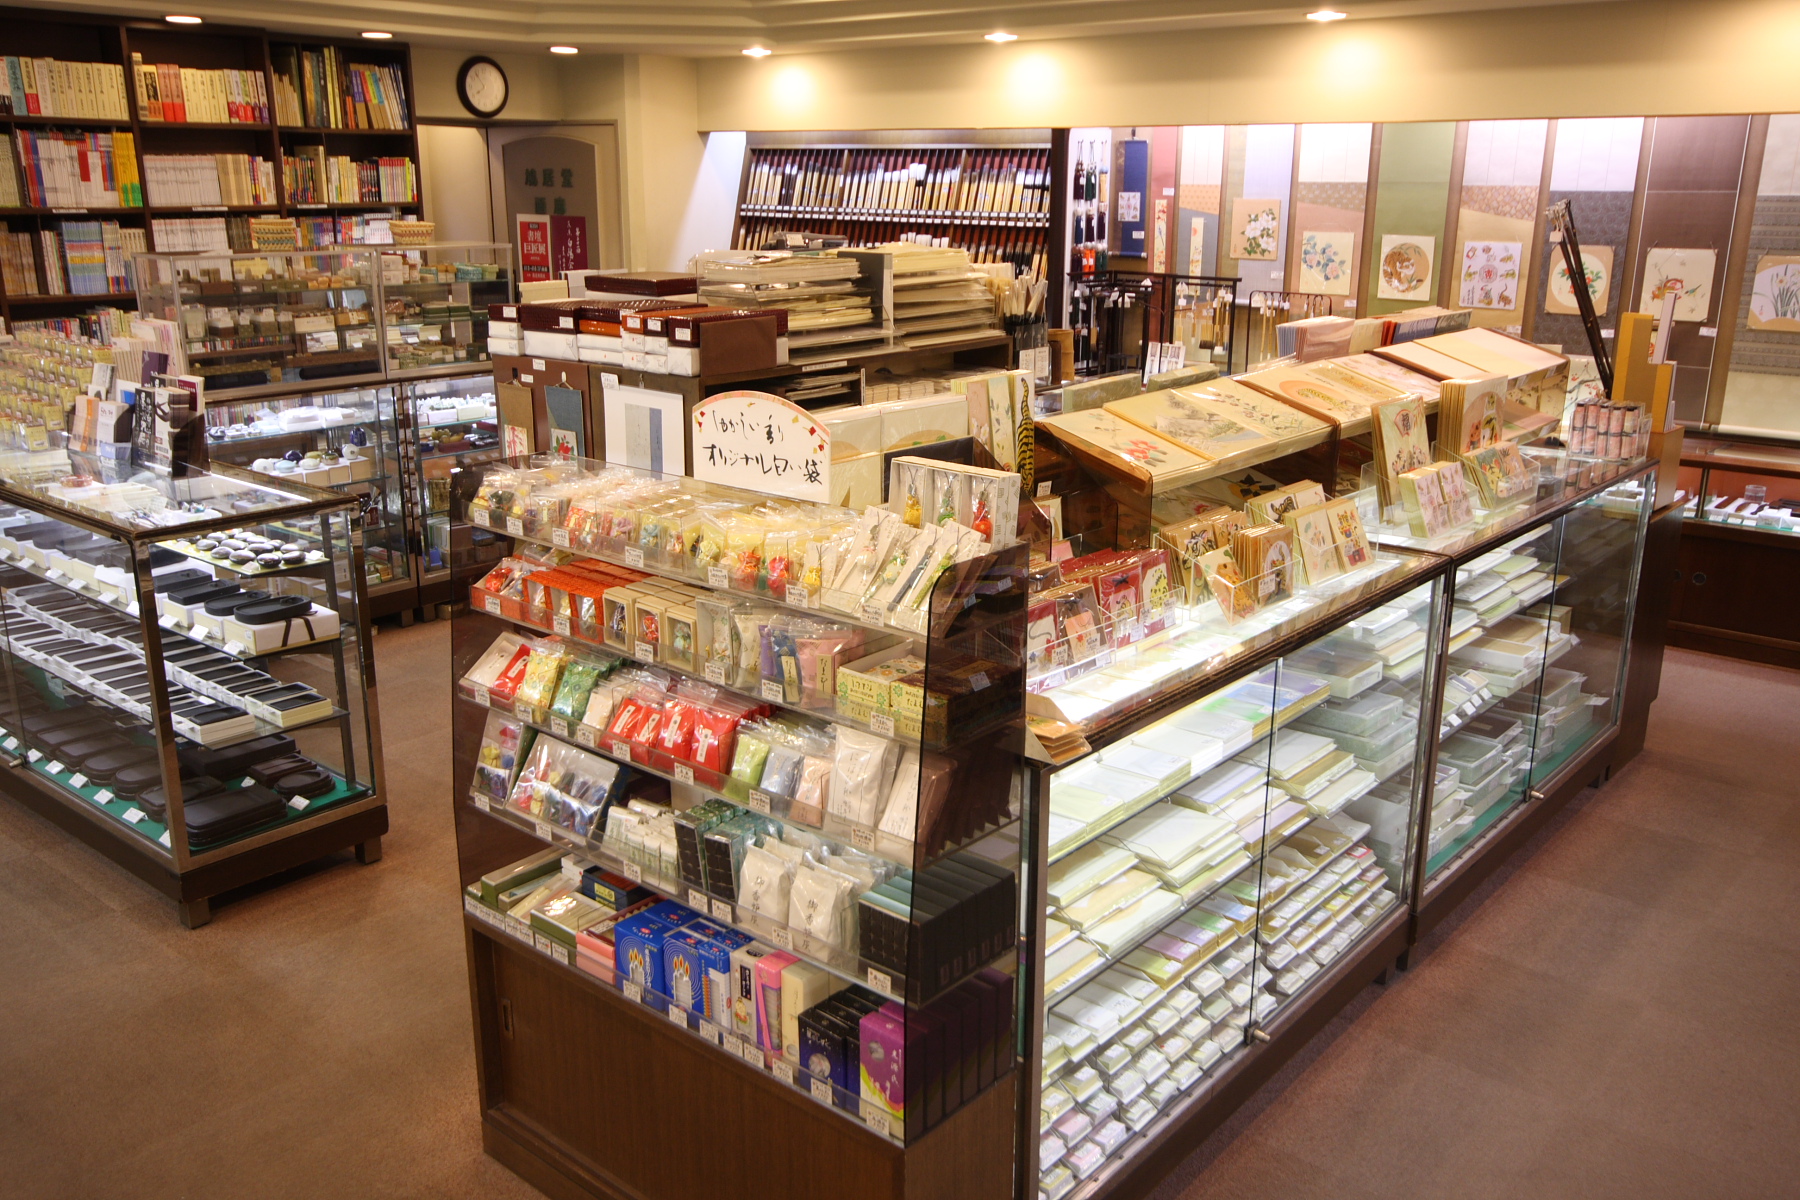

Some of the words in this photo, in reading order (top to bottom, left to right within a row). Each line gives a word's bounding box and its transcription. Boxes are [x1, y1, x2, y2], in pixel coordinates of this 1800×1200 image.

[702, 443, 823, 485] オリジナル匂い袋
